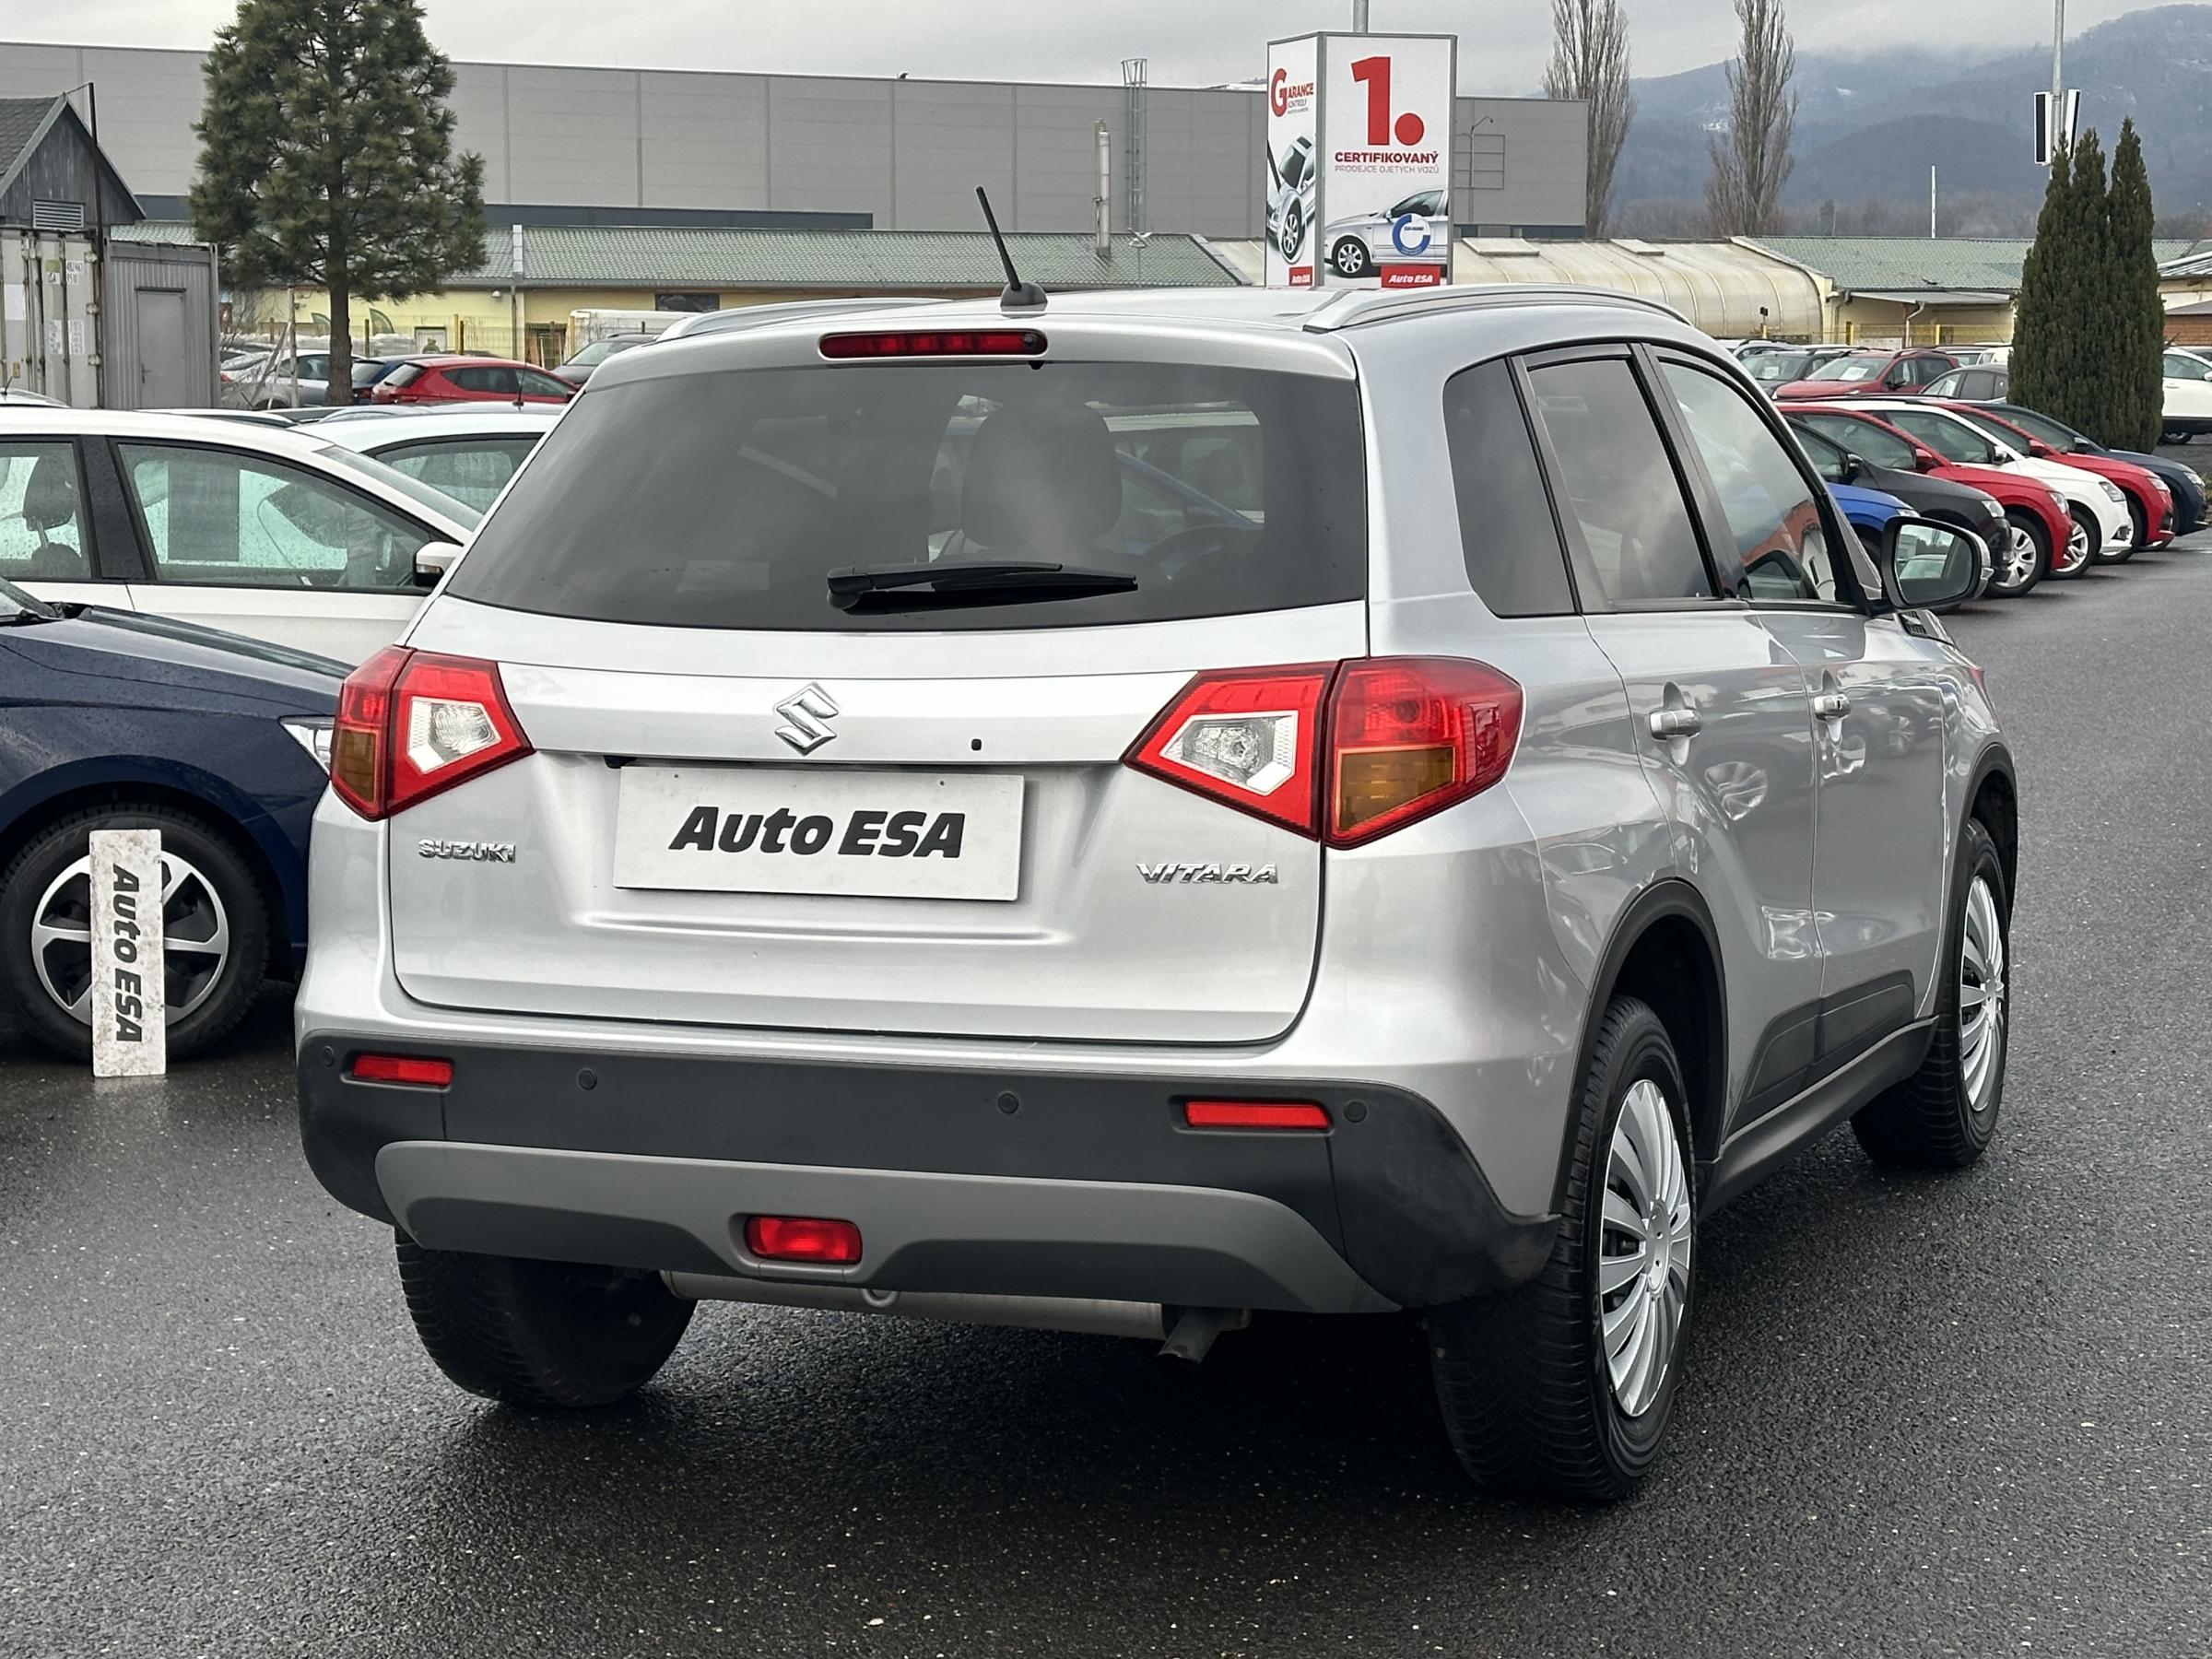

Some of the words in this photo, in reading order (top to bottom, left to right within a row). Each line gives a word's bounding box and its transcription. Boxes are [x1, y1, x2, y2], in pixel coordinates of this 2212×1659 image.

[1351, 56, 1425, 146] 1.
[1335, 150, 1439, 164] CERTIFIKOVANÝ
[1335, 165, 1377, 173] PRODEJCE
[1388, 274, 1414, 284] Auto
[1414, 274, 1433, 284] ESA
[668, 806, 833, 855] Auto
[838, 810, 966, 858] ESA
[418, 839, 516, 864] SUZUKI
[1136, 863, 1279, 885] VITARA
[112, 863, 140, 964] Auto
[114, 968, 143, 1042] ESA
